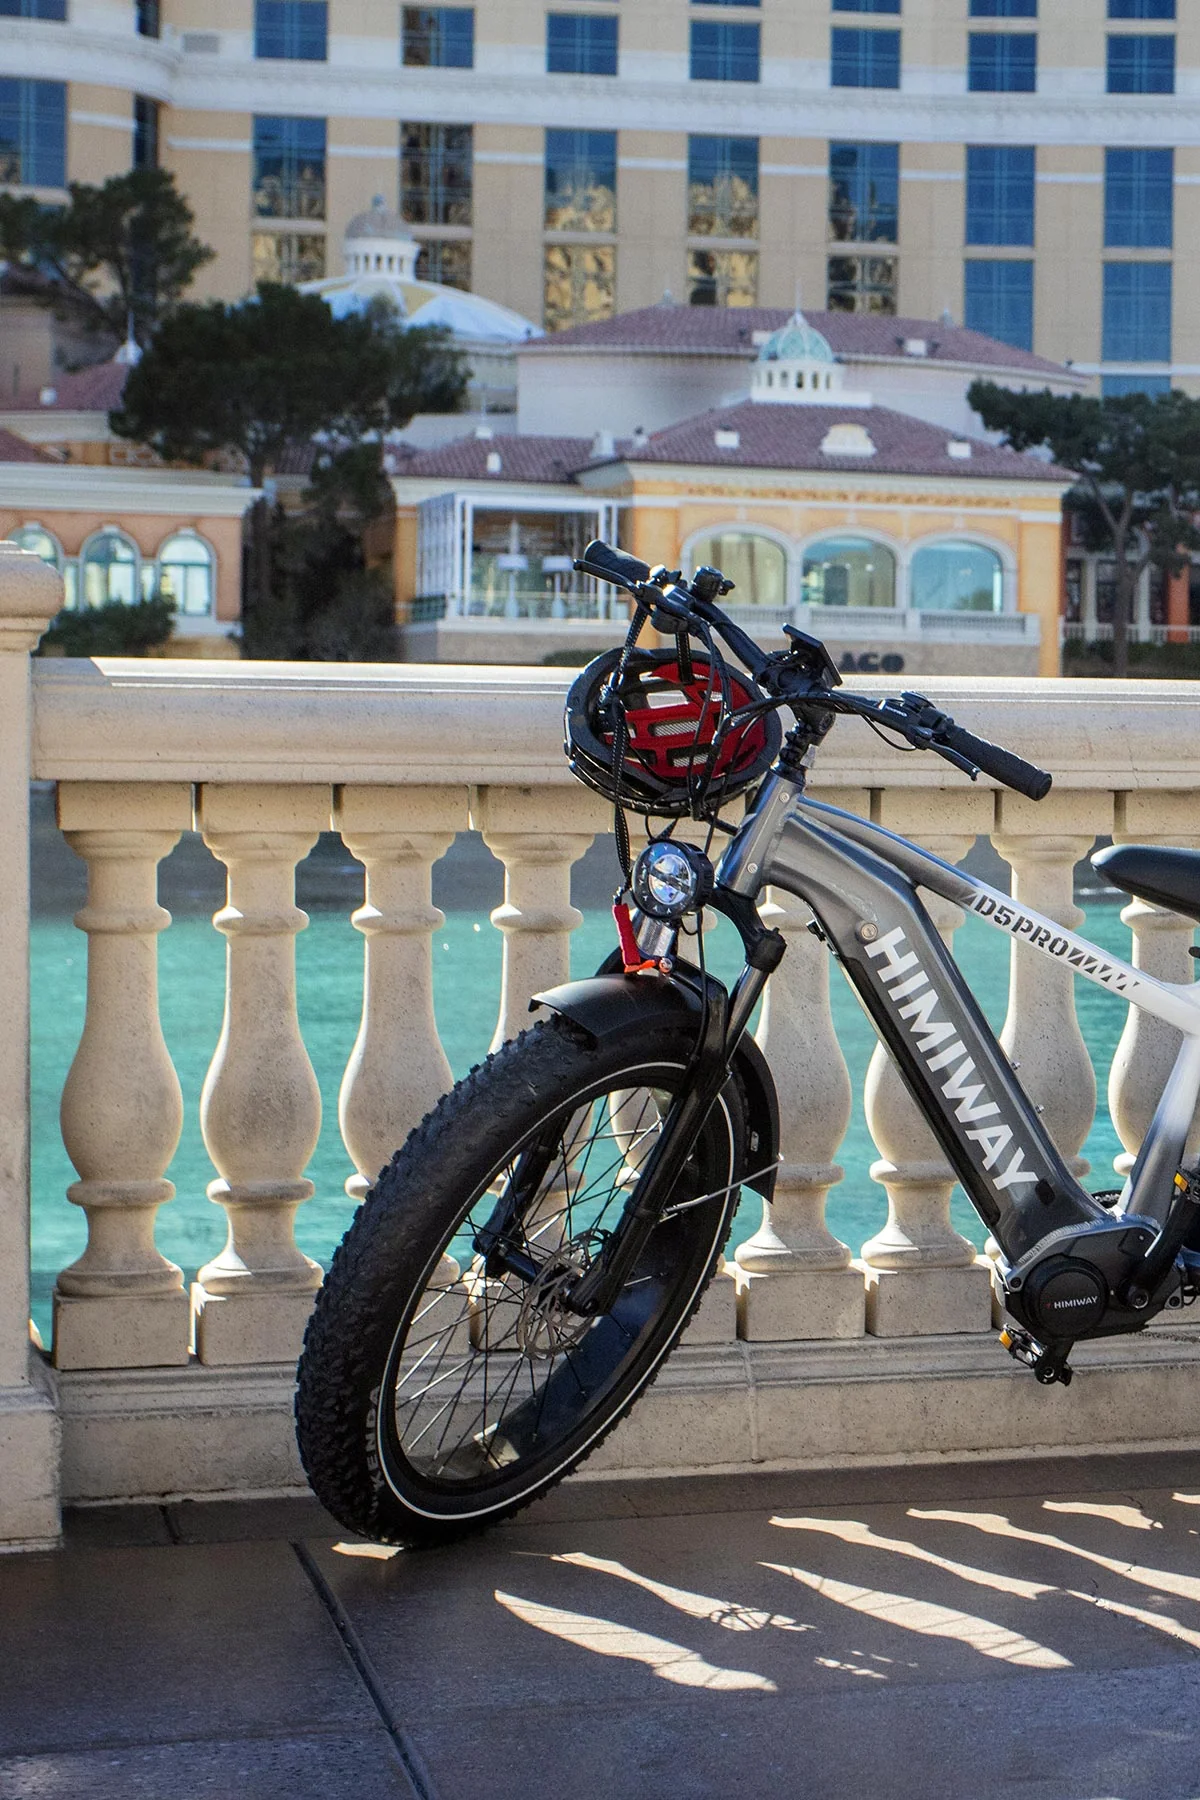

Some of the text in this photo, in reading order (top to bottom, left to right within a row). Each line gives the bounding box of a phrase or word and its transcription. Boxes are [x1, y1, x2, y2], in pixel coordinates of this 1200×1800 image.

[863, 926, 1039, 1191] HIMIWAY
[1053, 1295, 1098, 1309] HIMIWAY
[365, 1385, 385, 1492] KENDA
